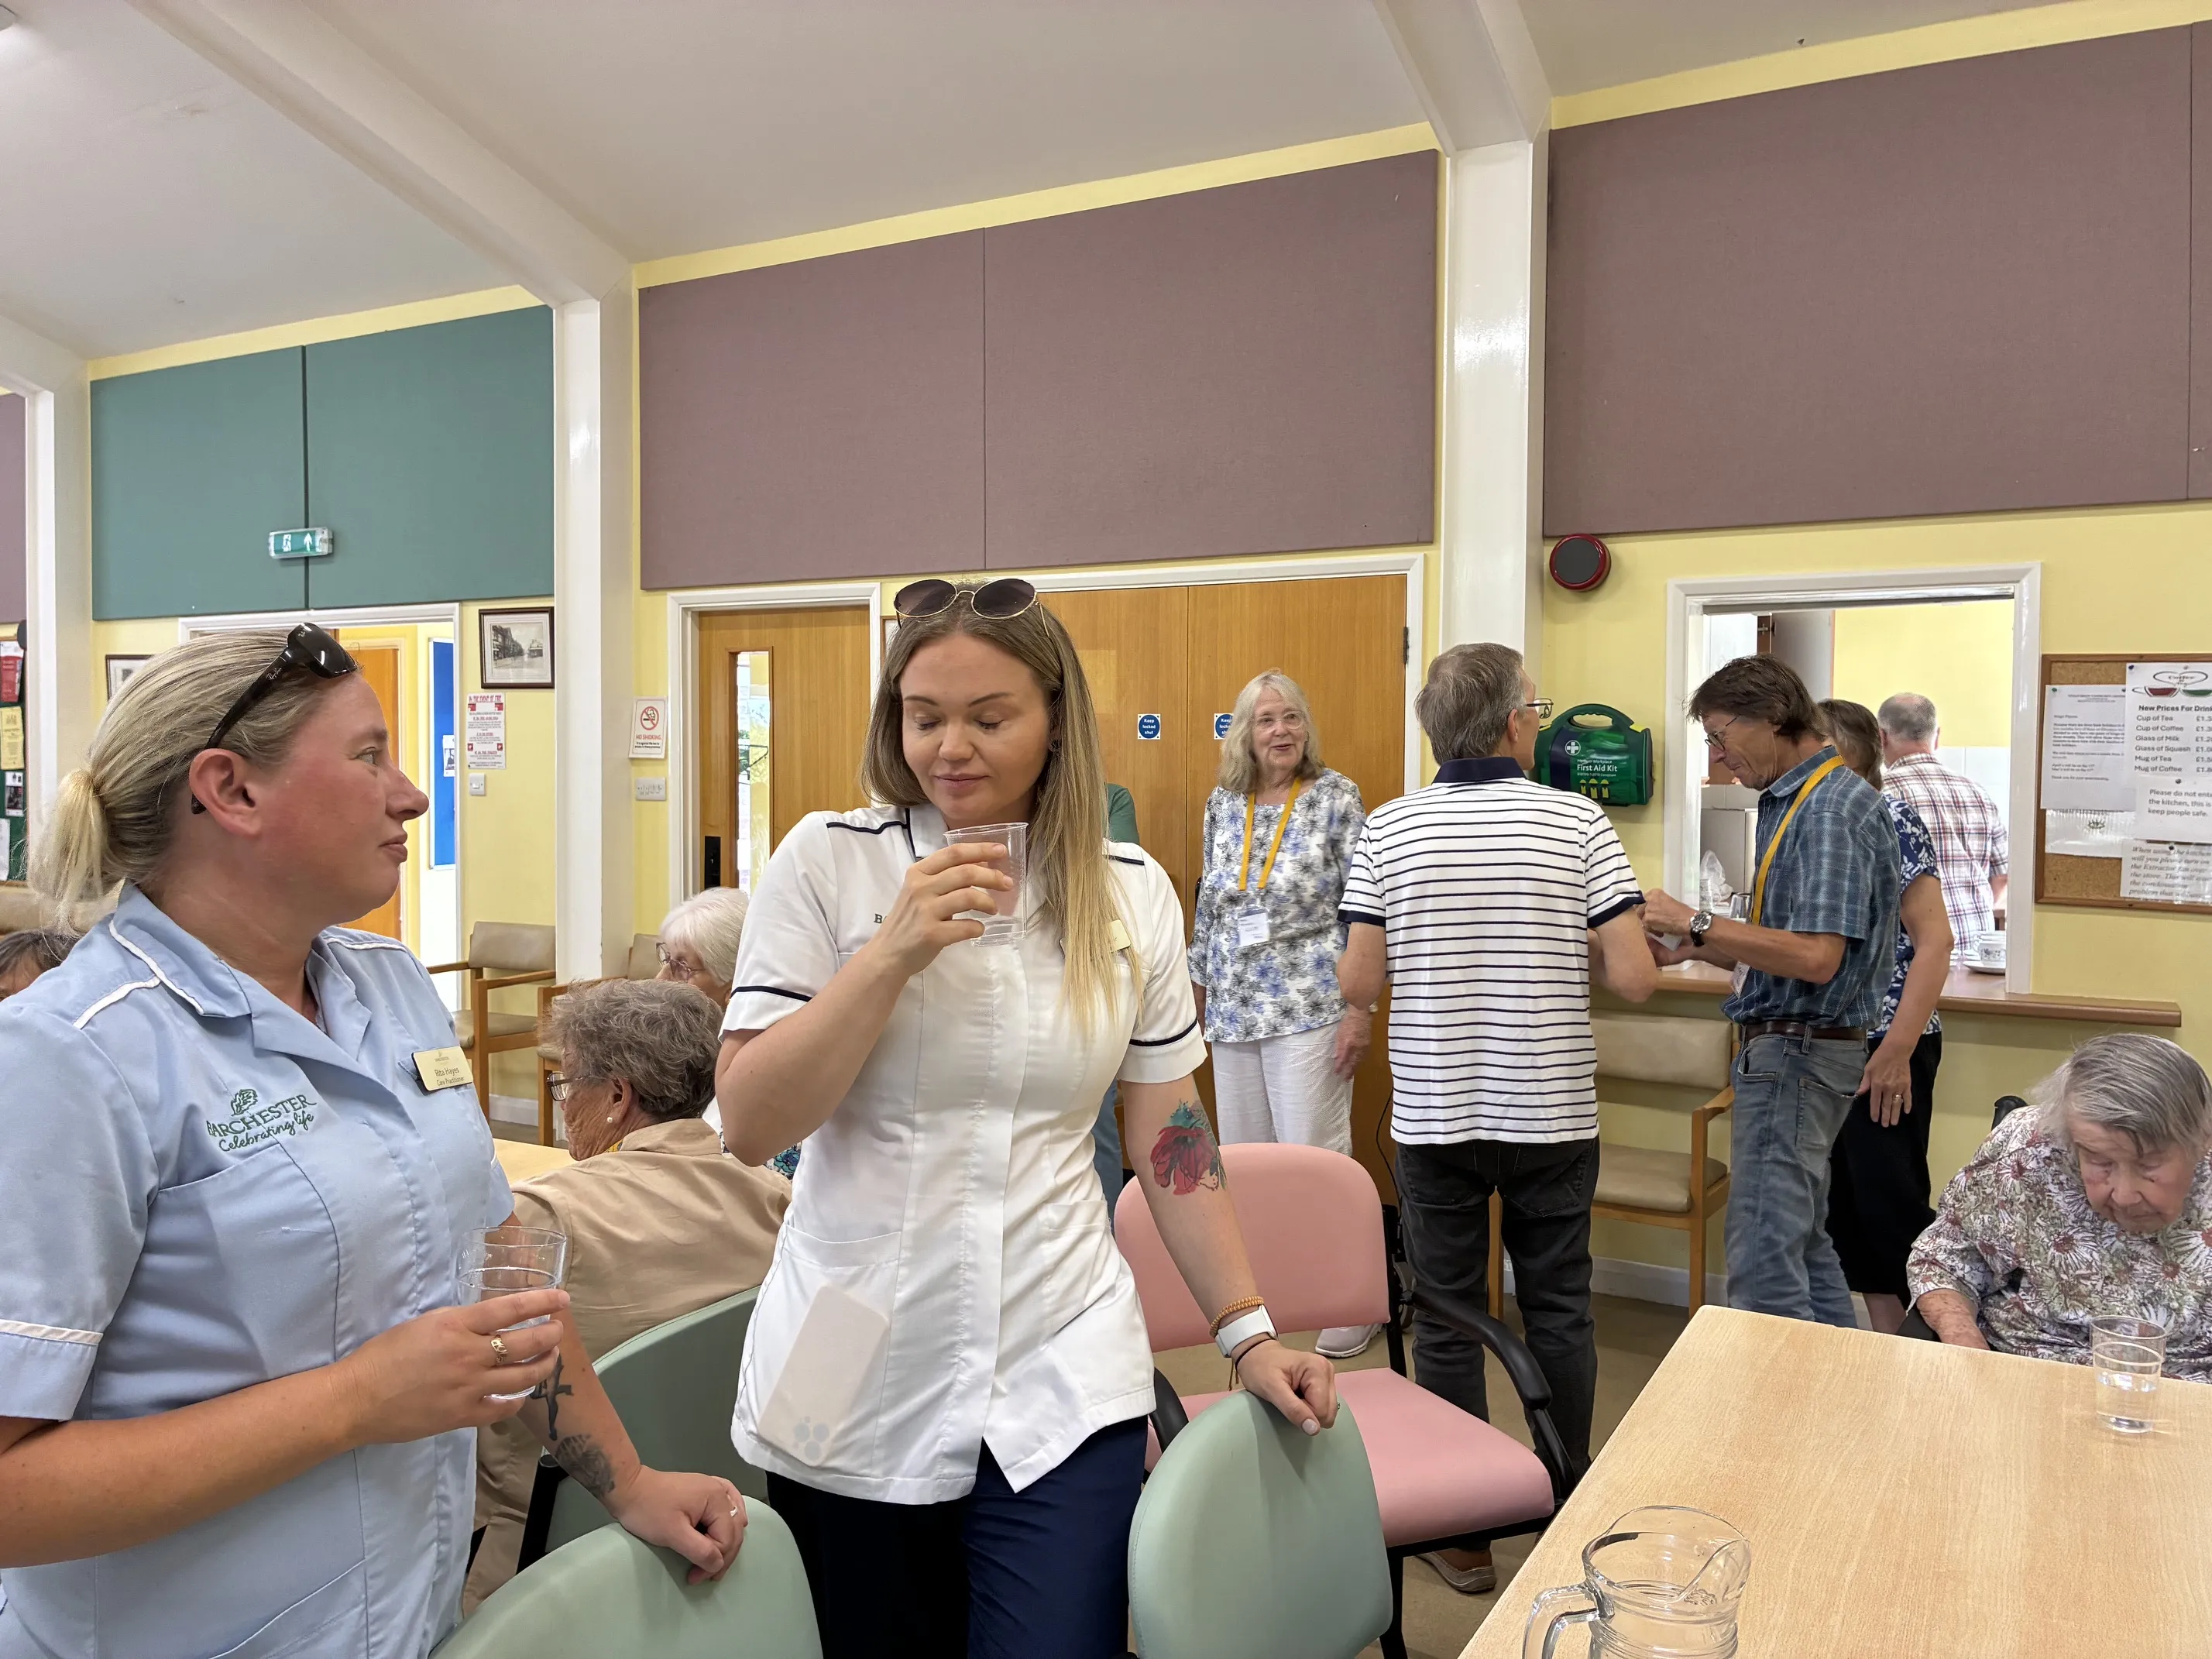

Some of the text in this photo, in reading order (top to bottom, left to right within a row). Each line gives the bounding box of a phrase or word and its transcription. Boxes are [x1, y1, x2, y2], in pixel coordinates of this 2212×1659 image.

[2148, 807, 2165, 816] keep
[434, 1067, 459, 1077] Rita Hayes
[206, 1094, 317, 1137] BARCHESTER
[219, 1110, 314, 1152] Celebrating life
